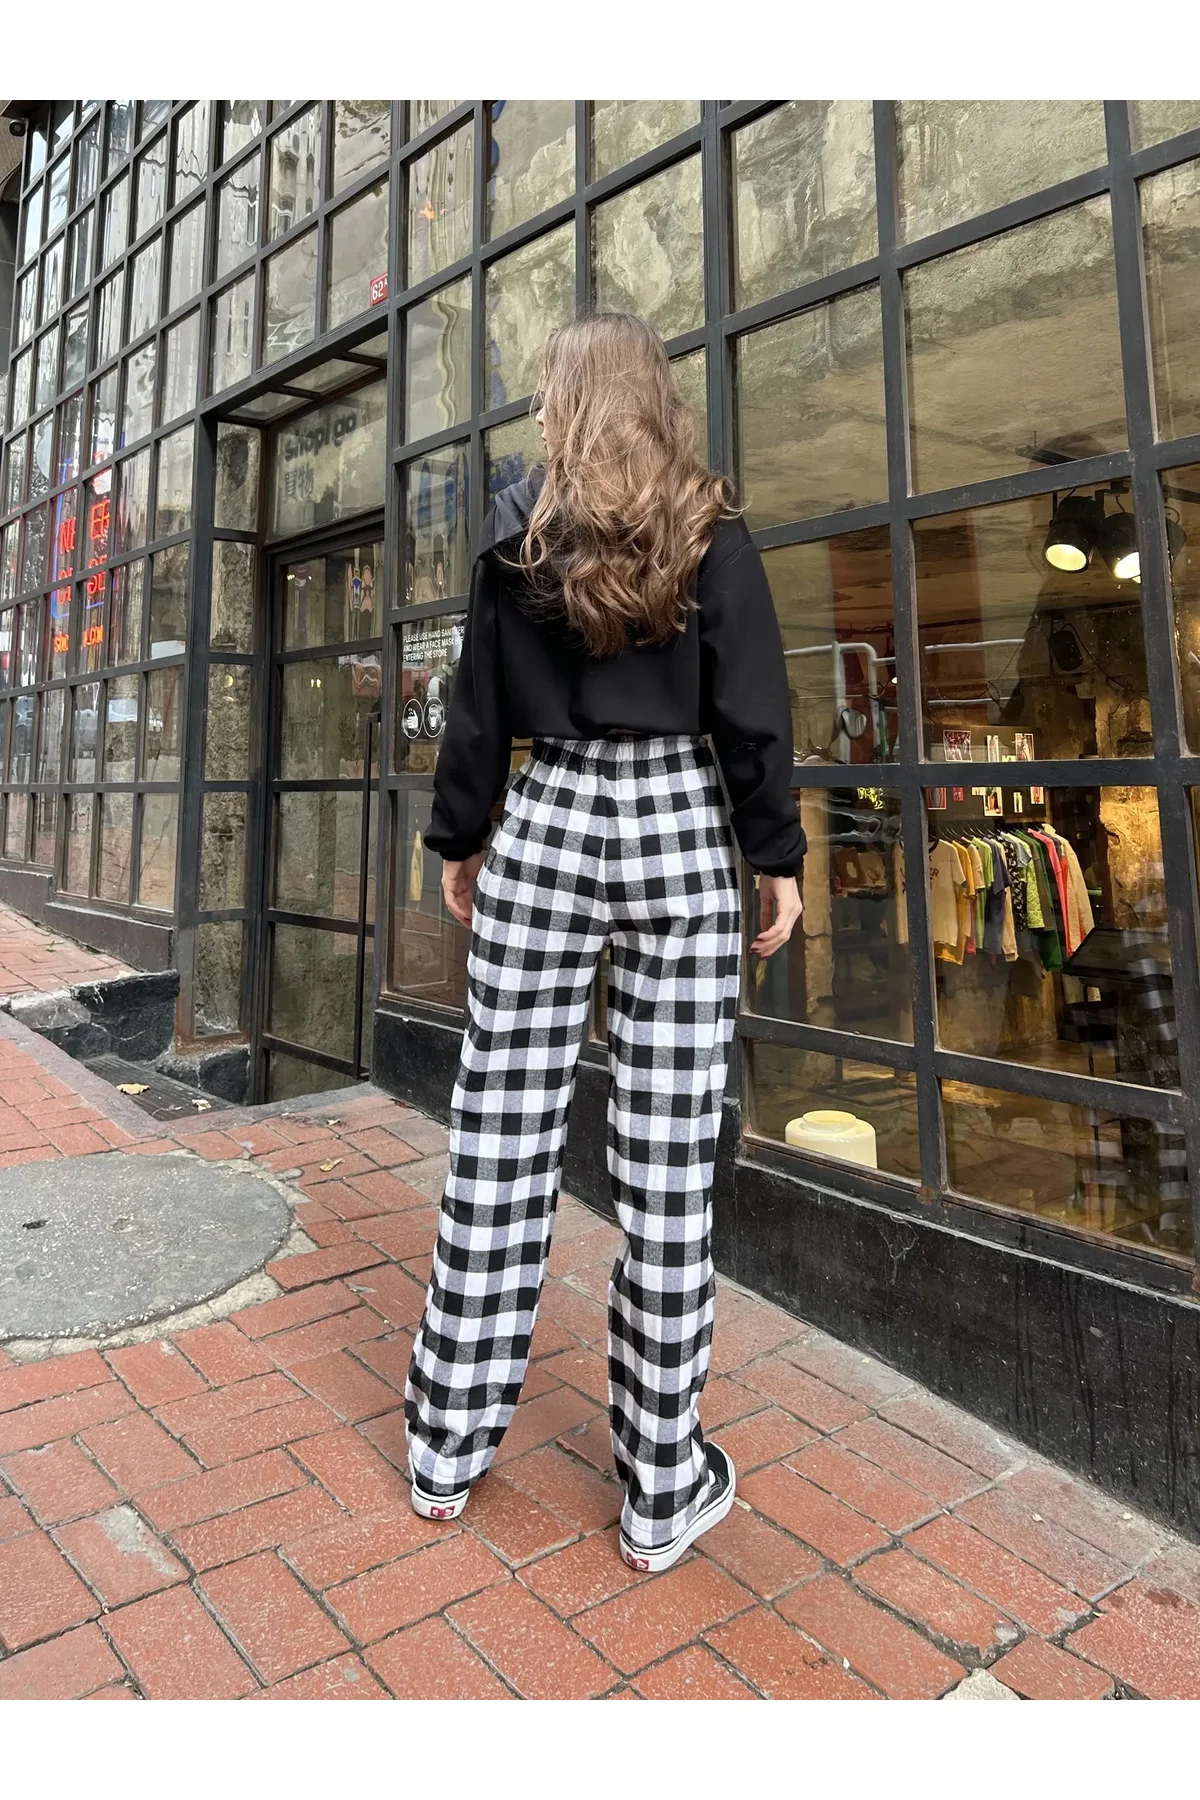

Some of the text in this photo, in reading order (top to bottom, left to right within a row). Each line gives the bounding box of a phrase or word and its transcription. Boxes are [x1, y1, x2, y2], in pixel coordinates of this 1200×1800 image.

[334, 412, 357, 448] go
[403, 633, 419, 643] PLEASE
[419, 631, 428, 641] USE
[429, 630, 441, 639] HAND
[403, 644, 413, 652] AND
[412, 641, 425, 651] WEAR
[430, 639, 441, 649] FACE
[402, 648, 448, 662] ENTERING THE STORE
